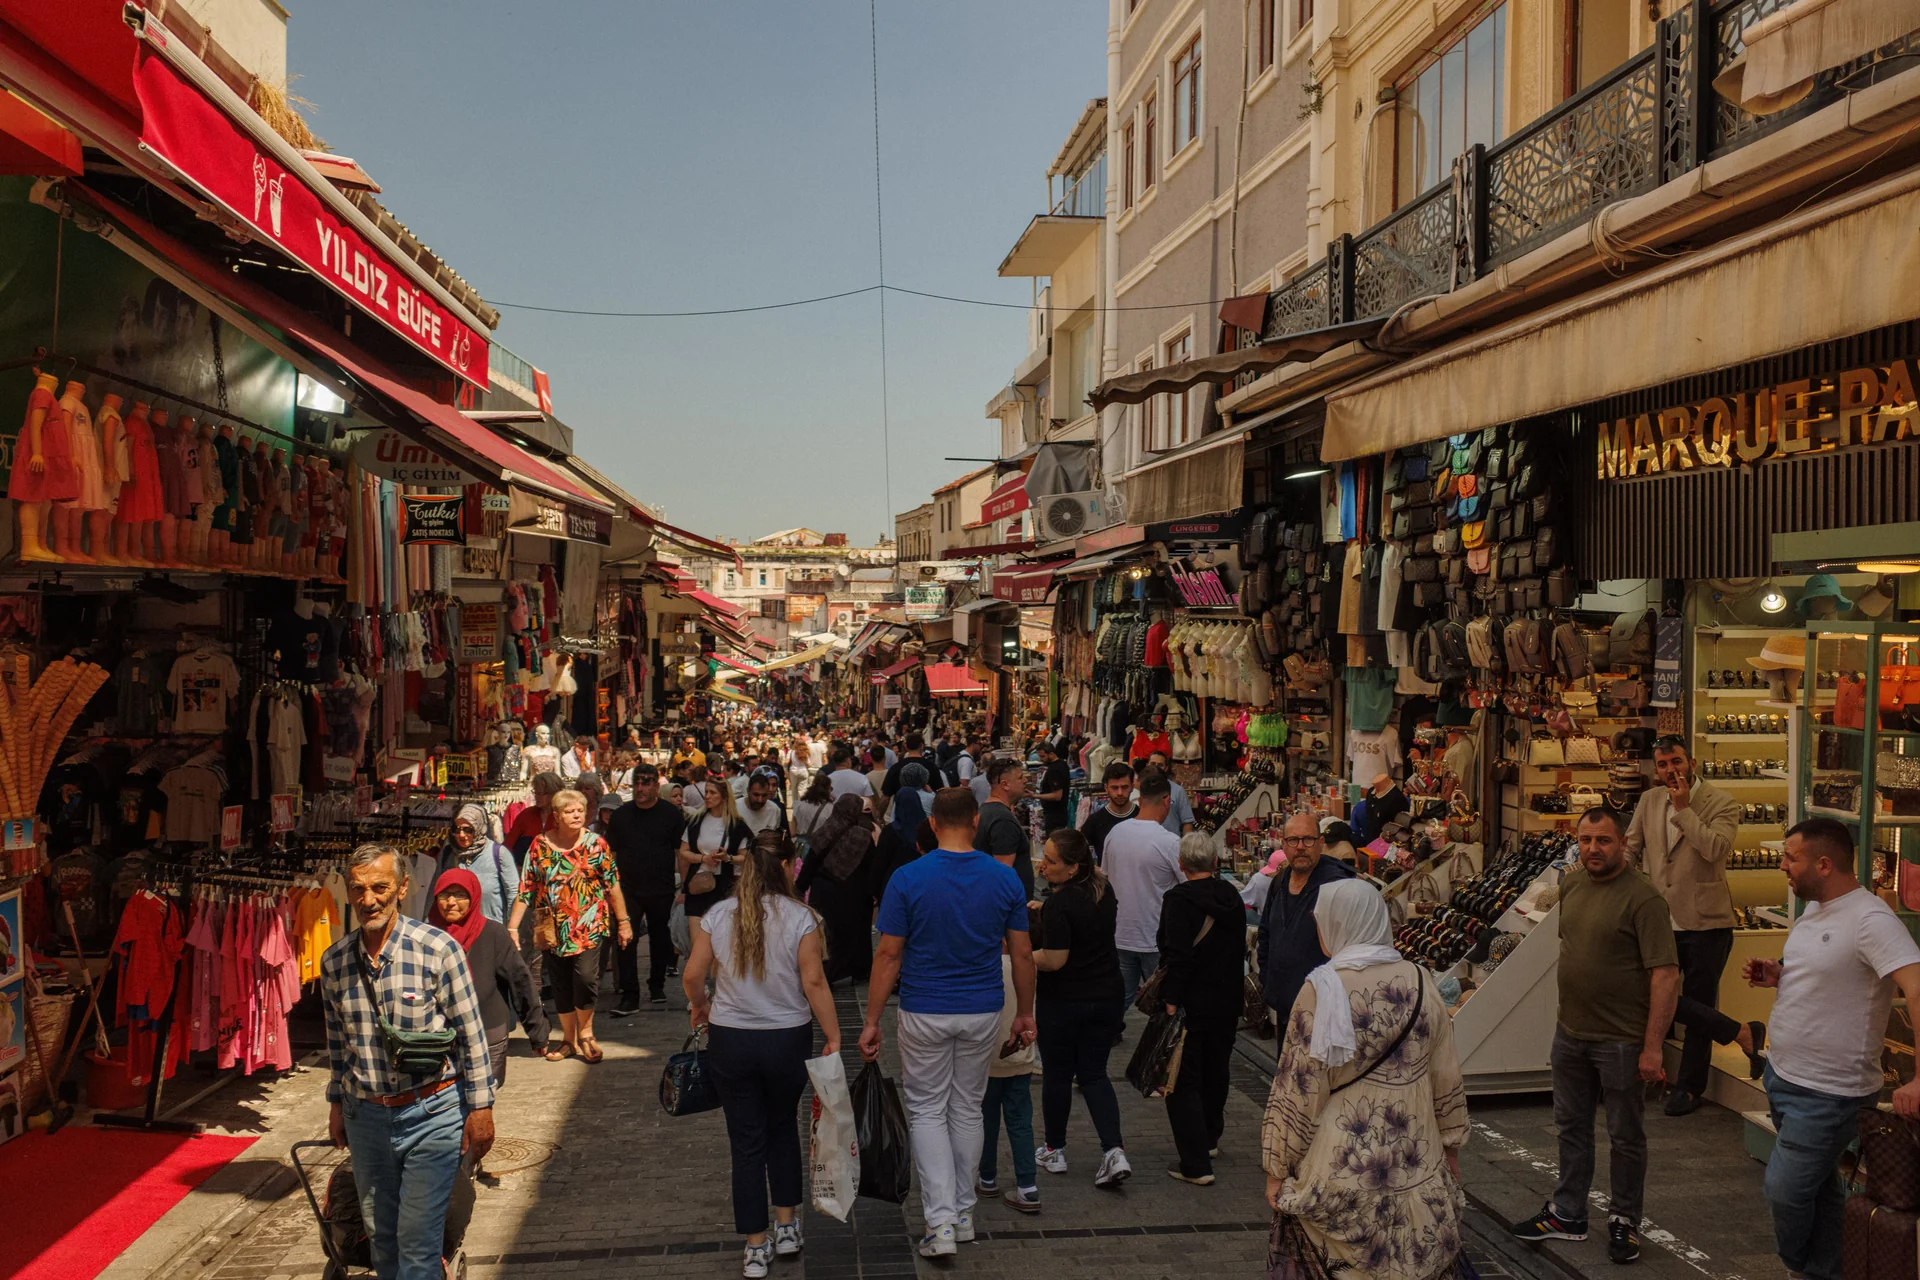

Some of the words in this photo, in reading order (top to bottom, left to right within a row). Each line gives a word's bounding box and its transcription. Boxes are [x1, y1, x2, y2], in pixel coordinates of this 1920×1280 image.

[315, 217, 389, 311] YILDIZ
[397, 285, 441, 349] BÜFE
[1598, 379, 1811, 480] MARQUE
[1837, 357, 1920, 447] PA
[392, 467, 408, 481] İÇ
[413, 468, 460, 481] GİYİM
[412, 528, 428, 538] SATIŞ
[463, 647, 494, 657] tailor
[1353, 741, 1380, 755] BOSS
